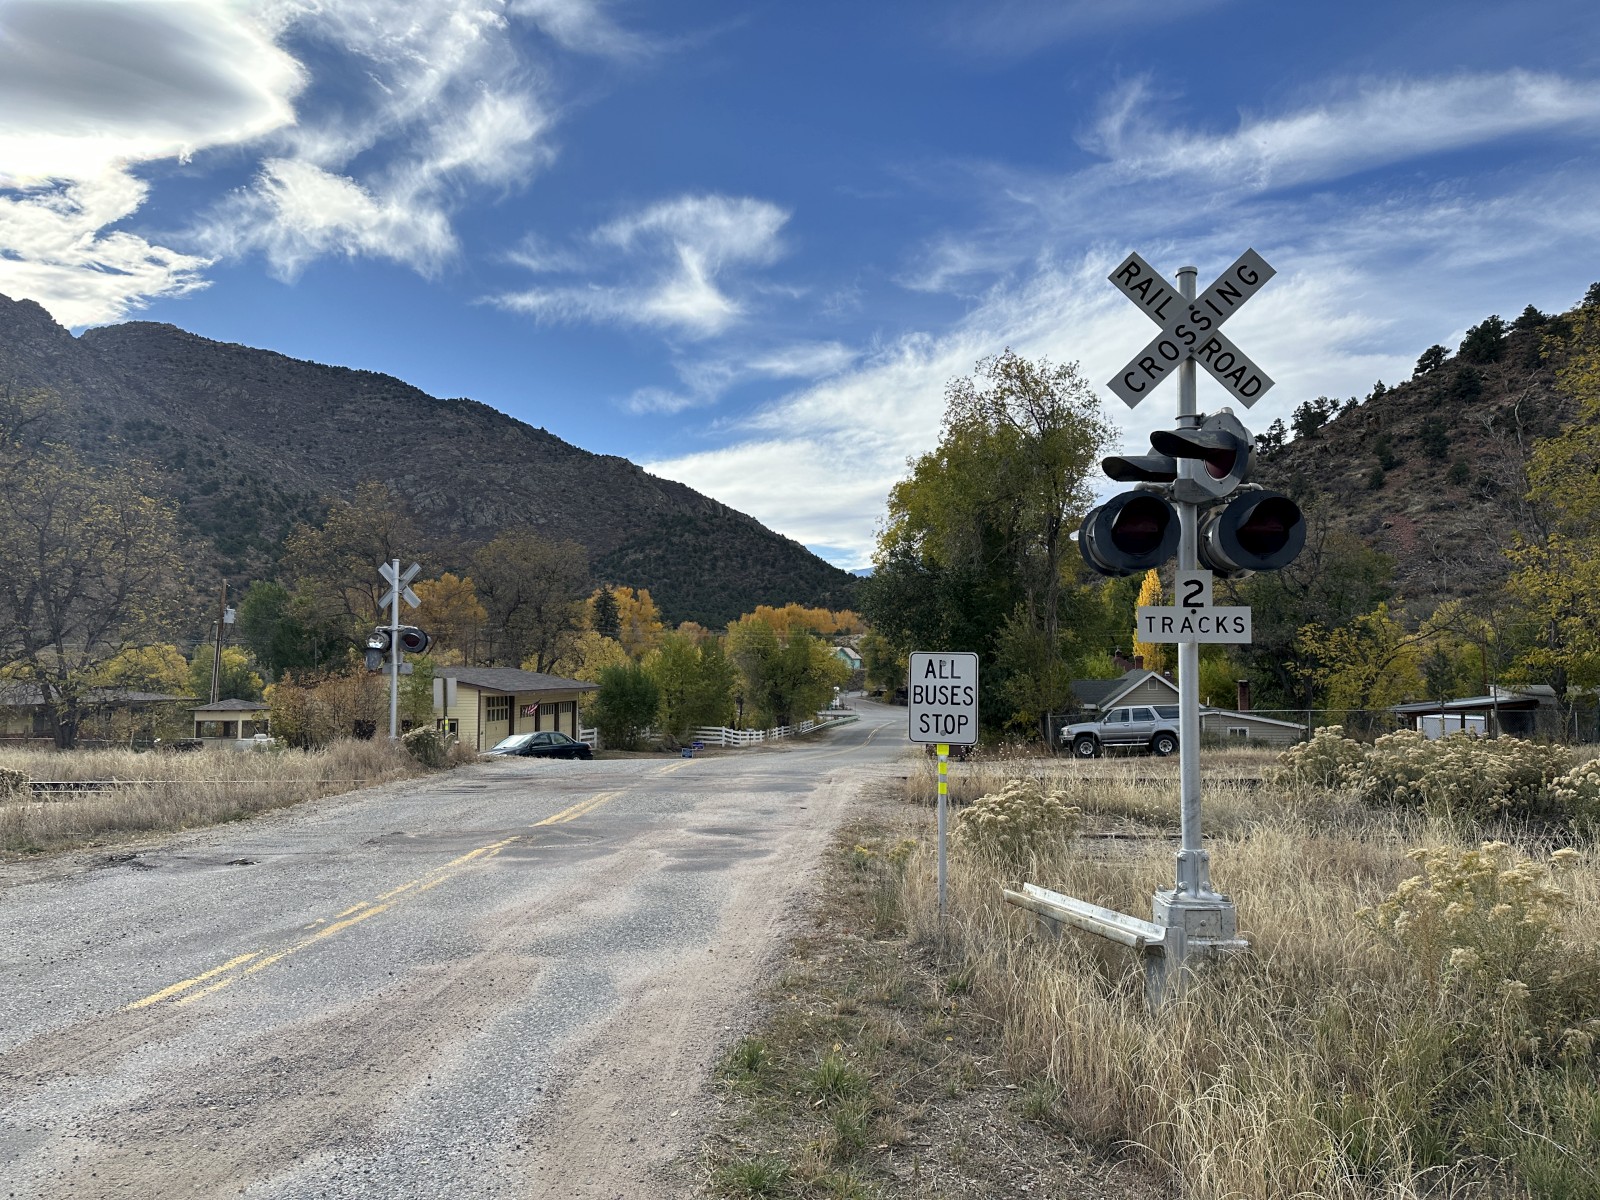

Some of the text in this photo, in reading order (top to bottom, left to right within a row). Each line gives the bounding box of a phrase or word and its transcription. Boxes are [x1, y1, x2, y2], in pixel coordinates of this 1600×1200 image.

[1116, 260, 1262, 398] RAIL ROAD
[1124, 264, 1259, 393] CROSSING
[1182, 579, 1205, 608] 2
[1145, 616, 1245, 634] TRACKS
[924, 658, 962, 679] ALL
[912, 684, 974, 706] BUSES
[919, 713, 969, 735] STOP
